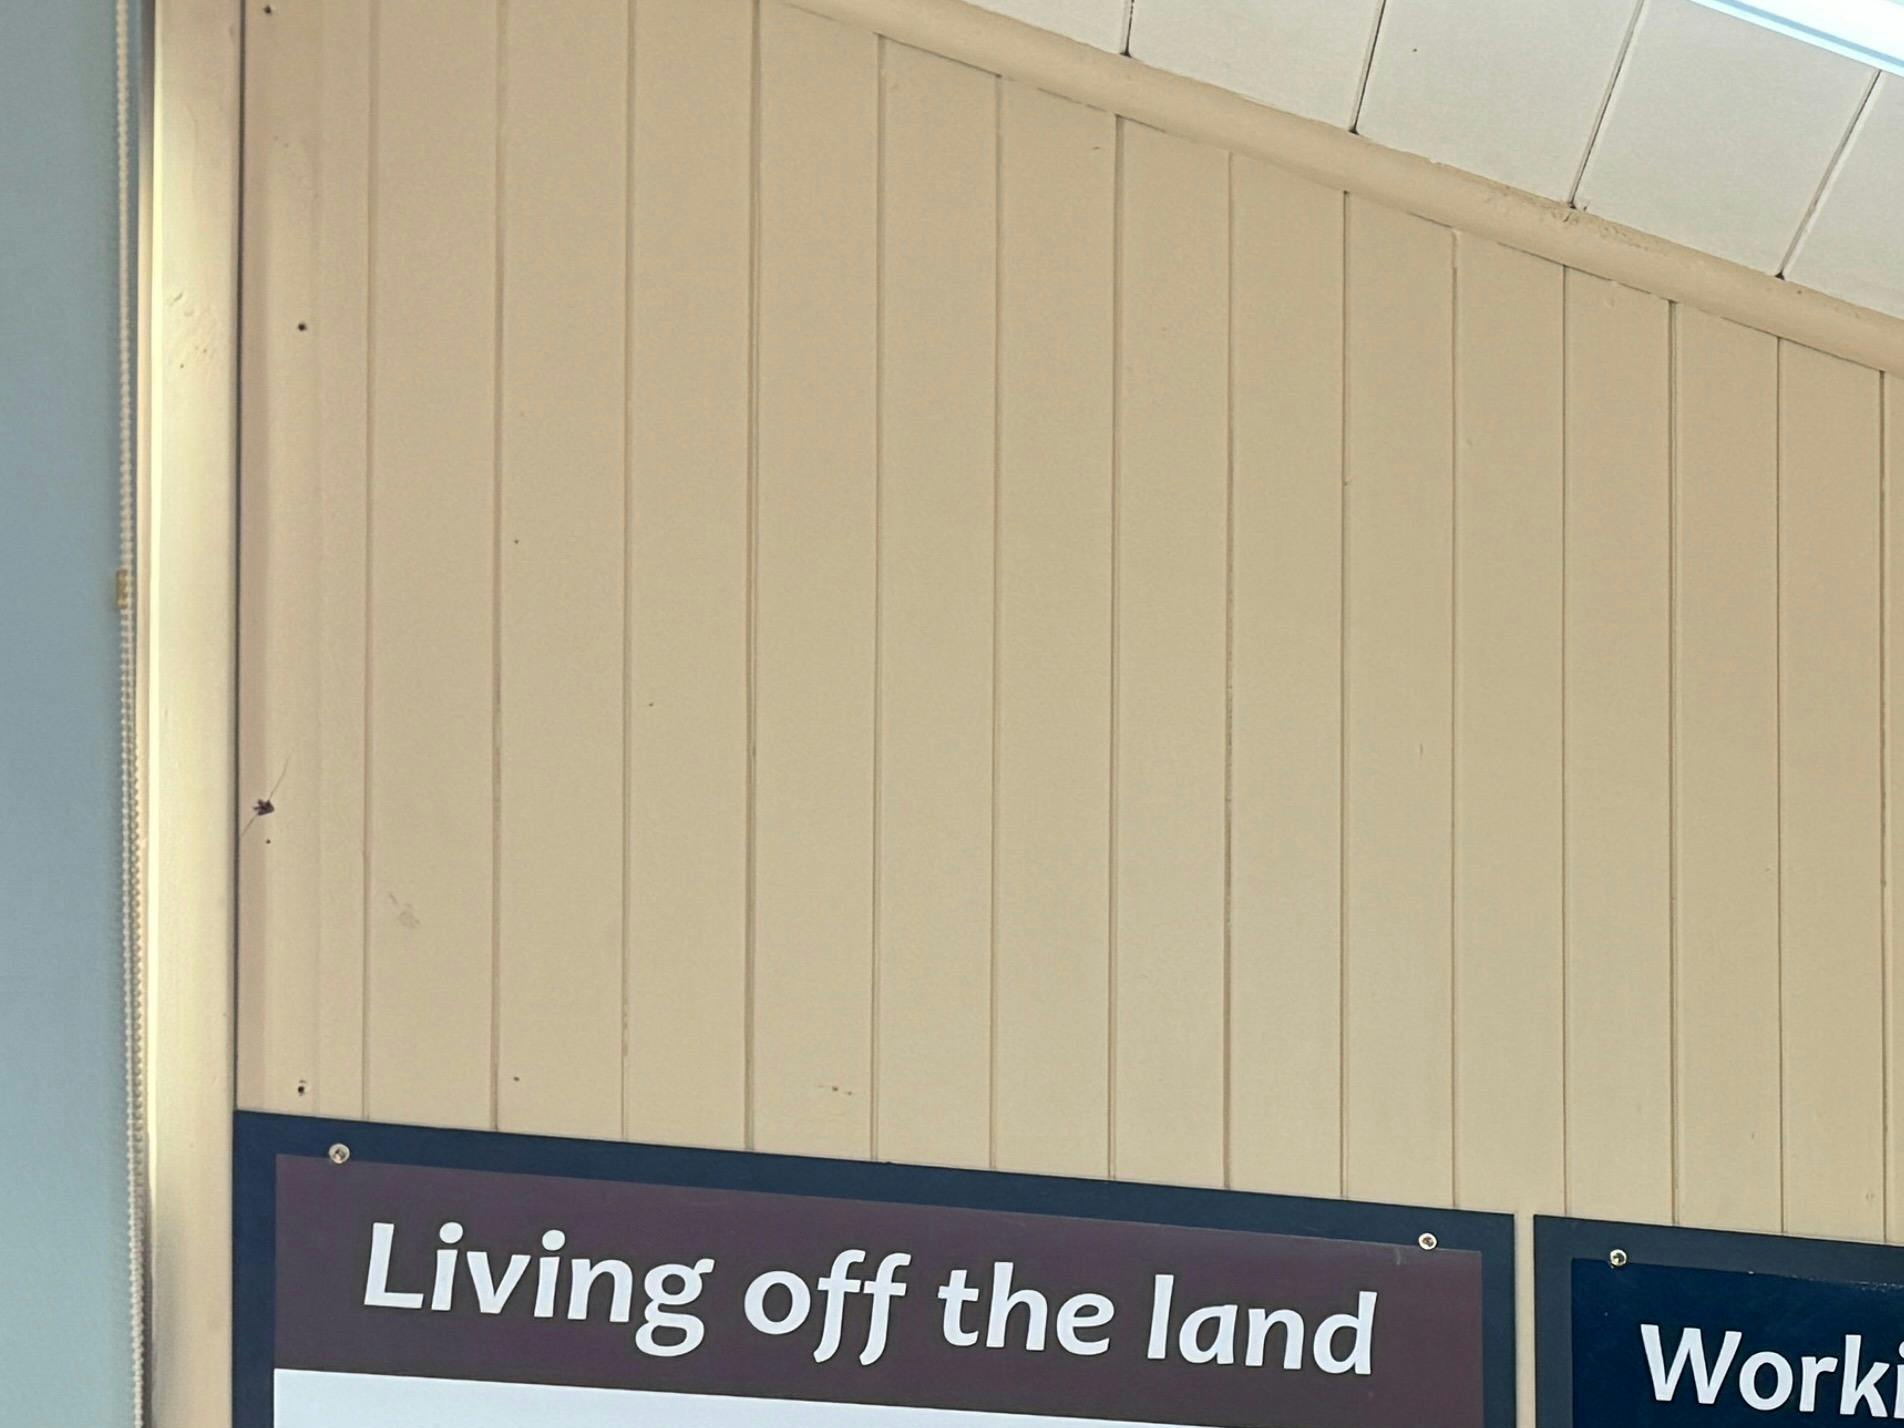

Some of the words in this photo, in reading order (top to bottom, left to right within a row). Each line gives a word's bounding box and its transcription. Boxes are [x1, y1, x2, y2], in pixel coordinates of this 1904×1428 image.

[363, 1221, 715, 1357] Living
[744, 1249, 912, 1366] off
[937, 1261, 1115, 1356] the
[1147, 1274, 1378, 1375] land
